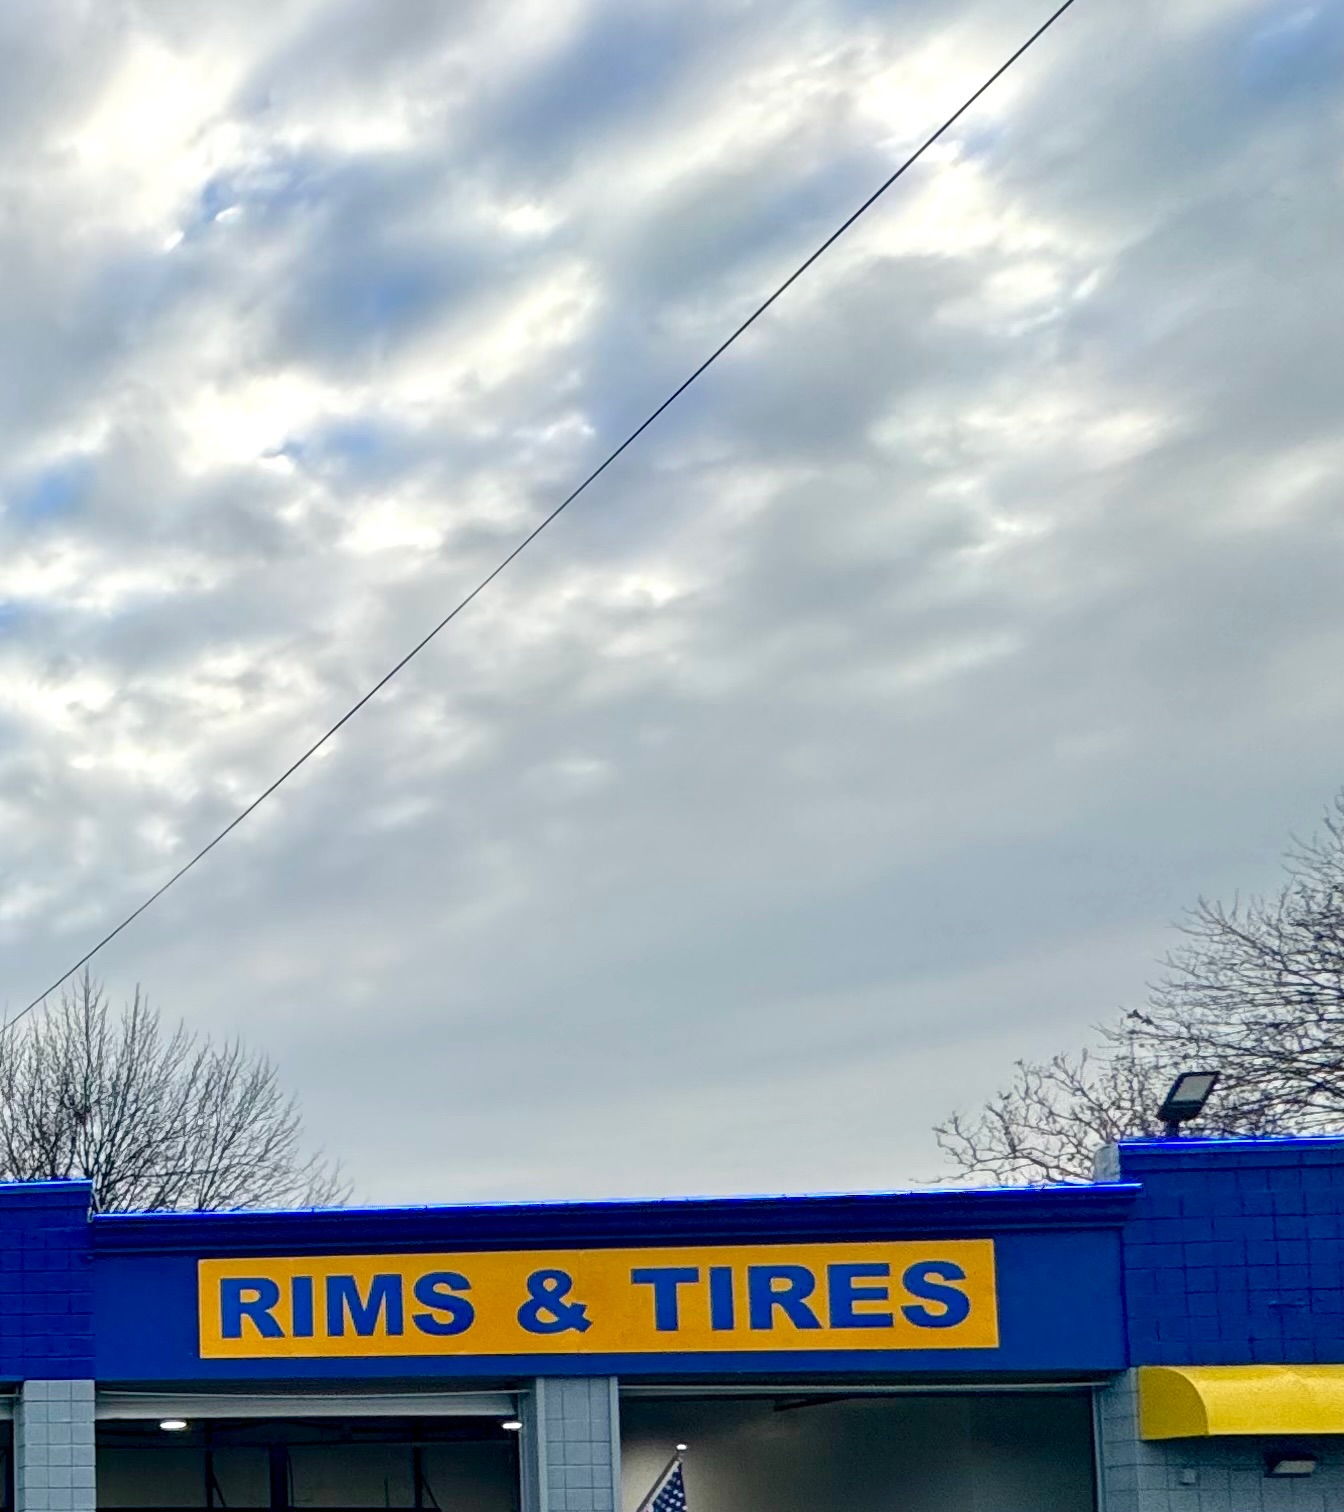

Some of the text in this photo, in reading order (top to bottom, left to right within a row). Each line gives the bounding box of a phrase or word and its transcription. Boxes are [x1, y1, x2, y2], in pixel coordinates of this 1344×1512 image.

[219, 1259, 972, 1340] RIMS & TIRES
